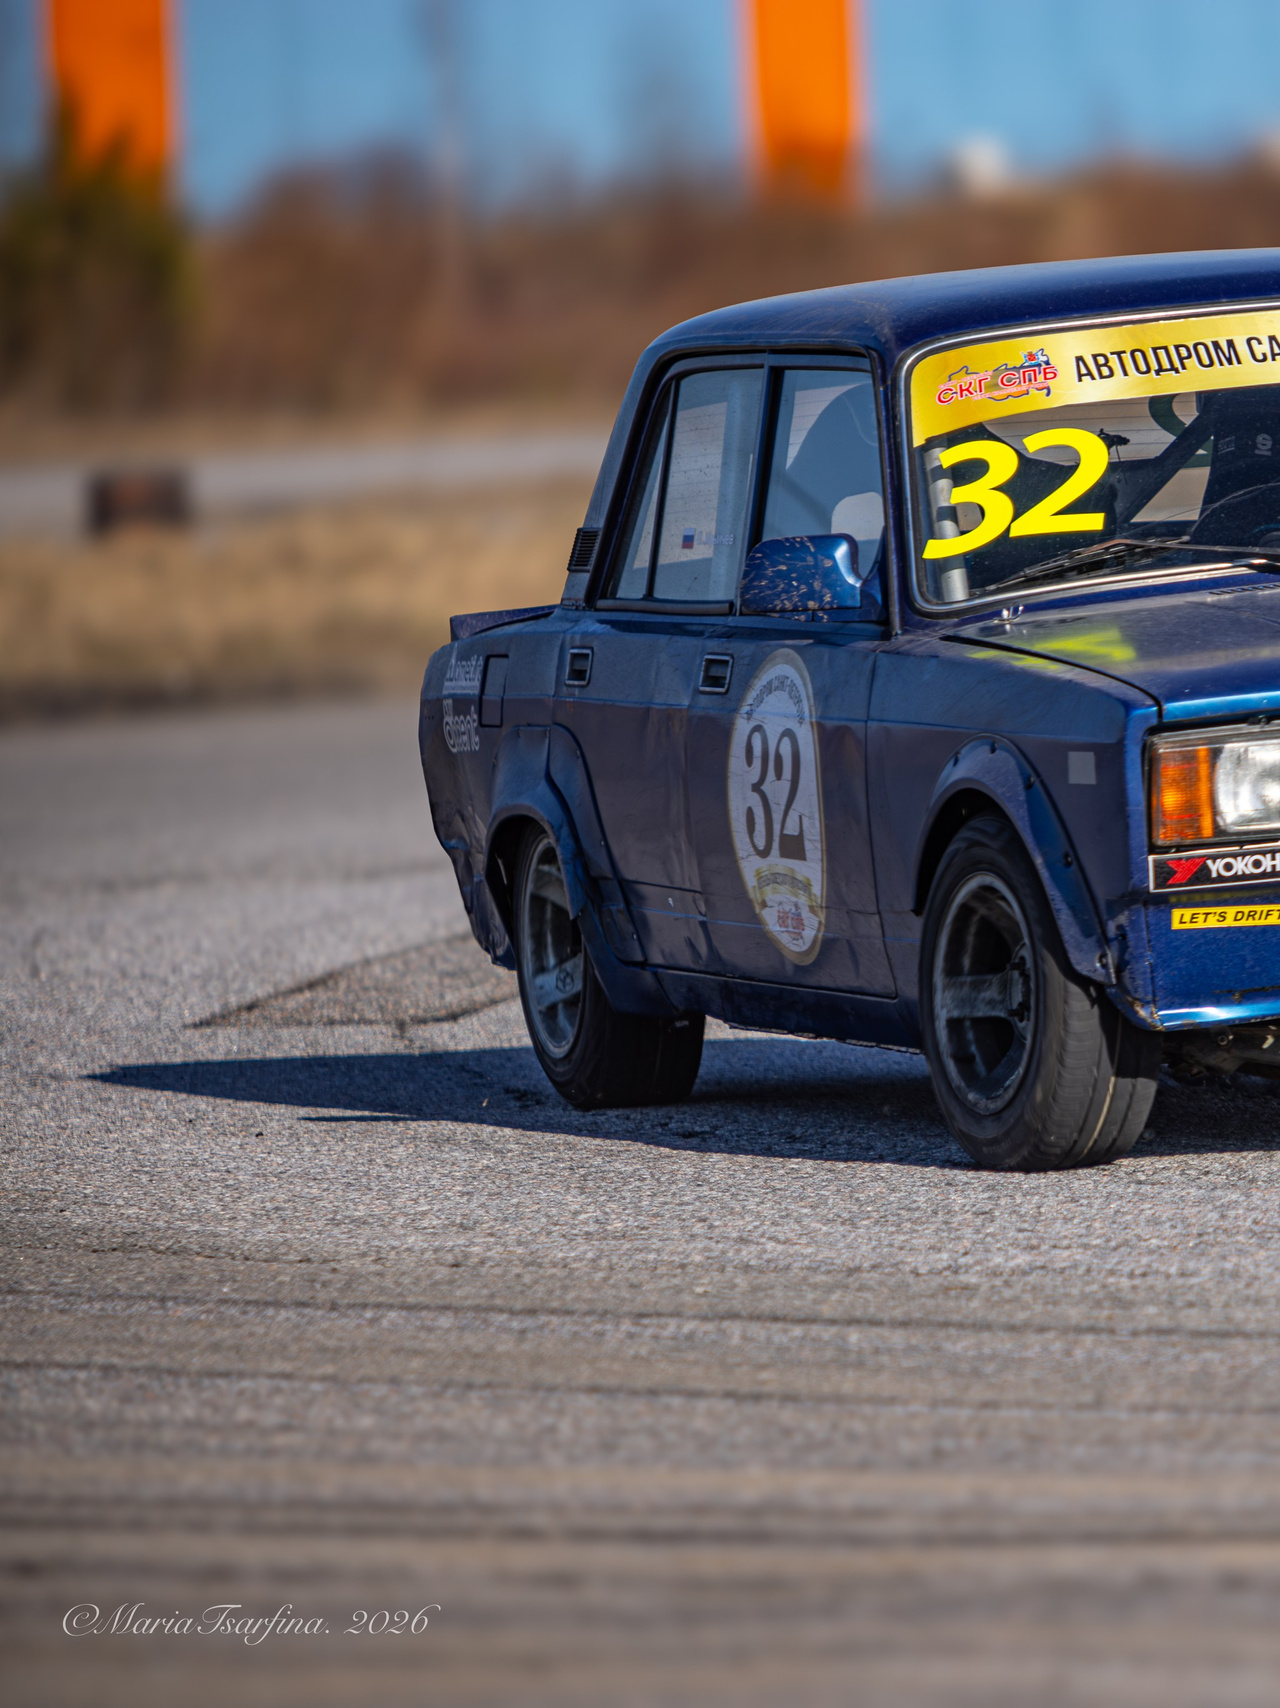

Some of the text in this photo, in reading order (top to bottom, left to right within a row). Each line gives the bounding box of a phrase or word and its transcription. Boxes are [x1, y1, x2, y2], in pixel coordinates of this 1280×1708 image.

[1074, 338, 1242, 383] АВТОДРОМ
[936, 376, 990, 405] СКГ
[998, 365, 1059, 388] СПБ
[922, 427, 1109, 559] 32
[745, 724, 807, 861] 32
[1179, 911, 1228, 925] LET'S
